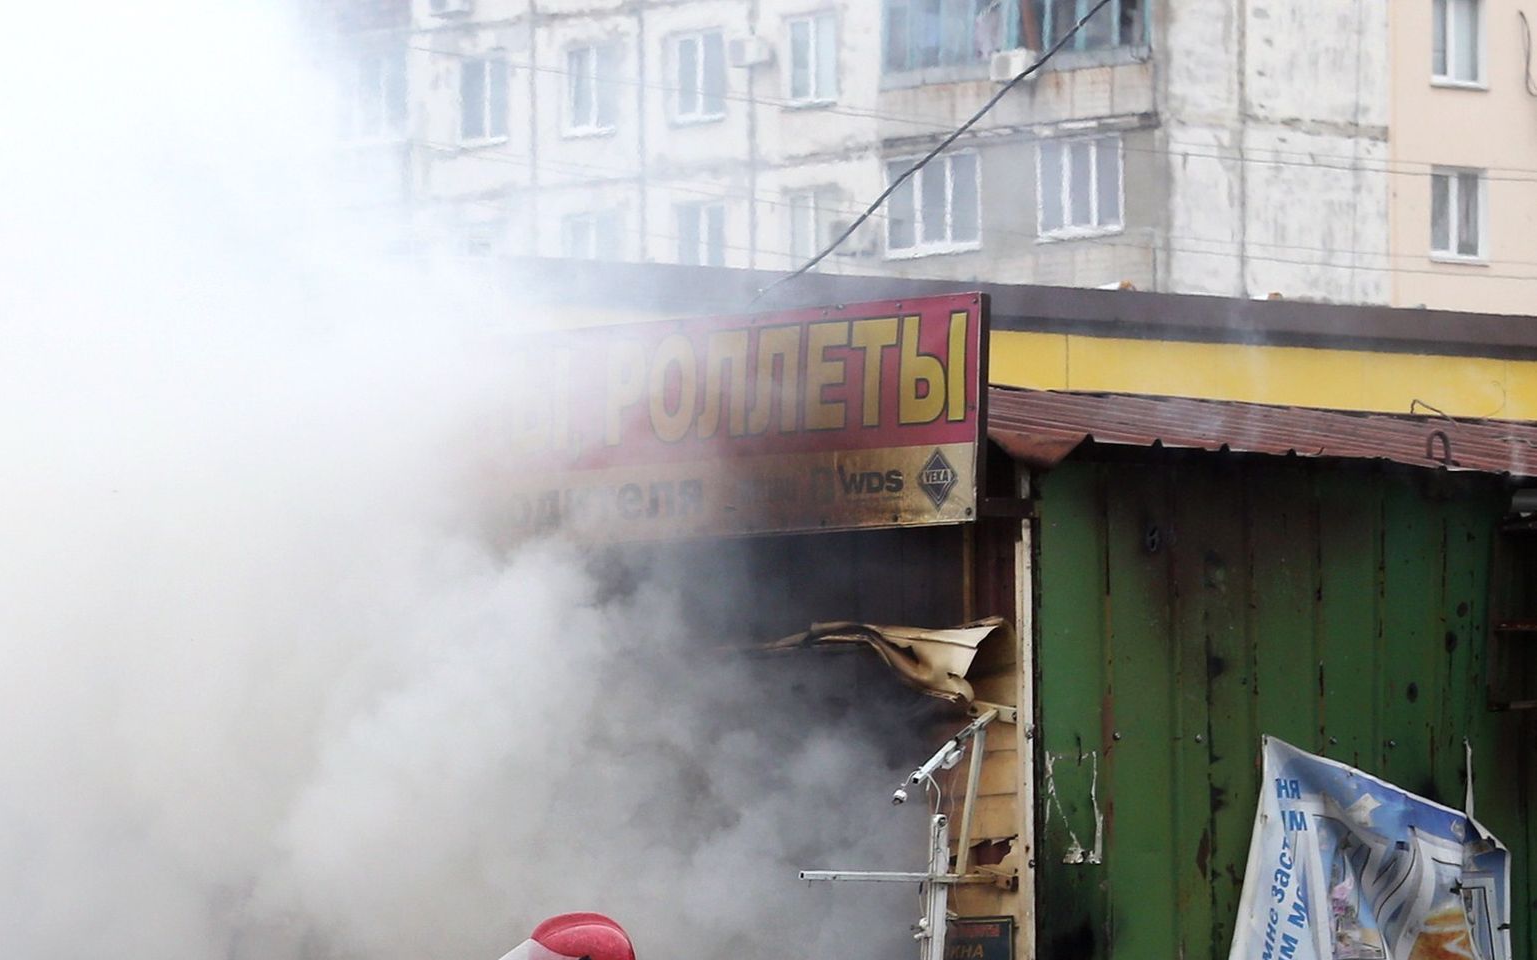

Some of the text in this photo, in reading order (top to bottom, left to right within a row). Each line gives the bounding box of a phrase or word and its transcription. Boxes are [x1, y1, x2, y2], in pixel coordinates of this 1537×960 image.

[605, 311, 969, 446] РОЛЛЕТЫ
[836, 464, 904, 495] WDS
[923, 468, 951, 484] VEKA
